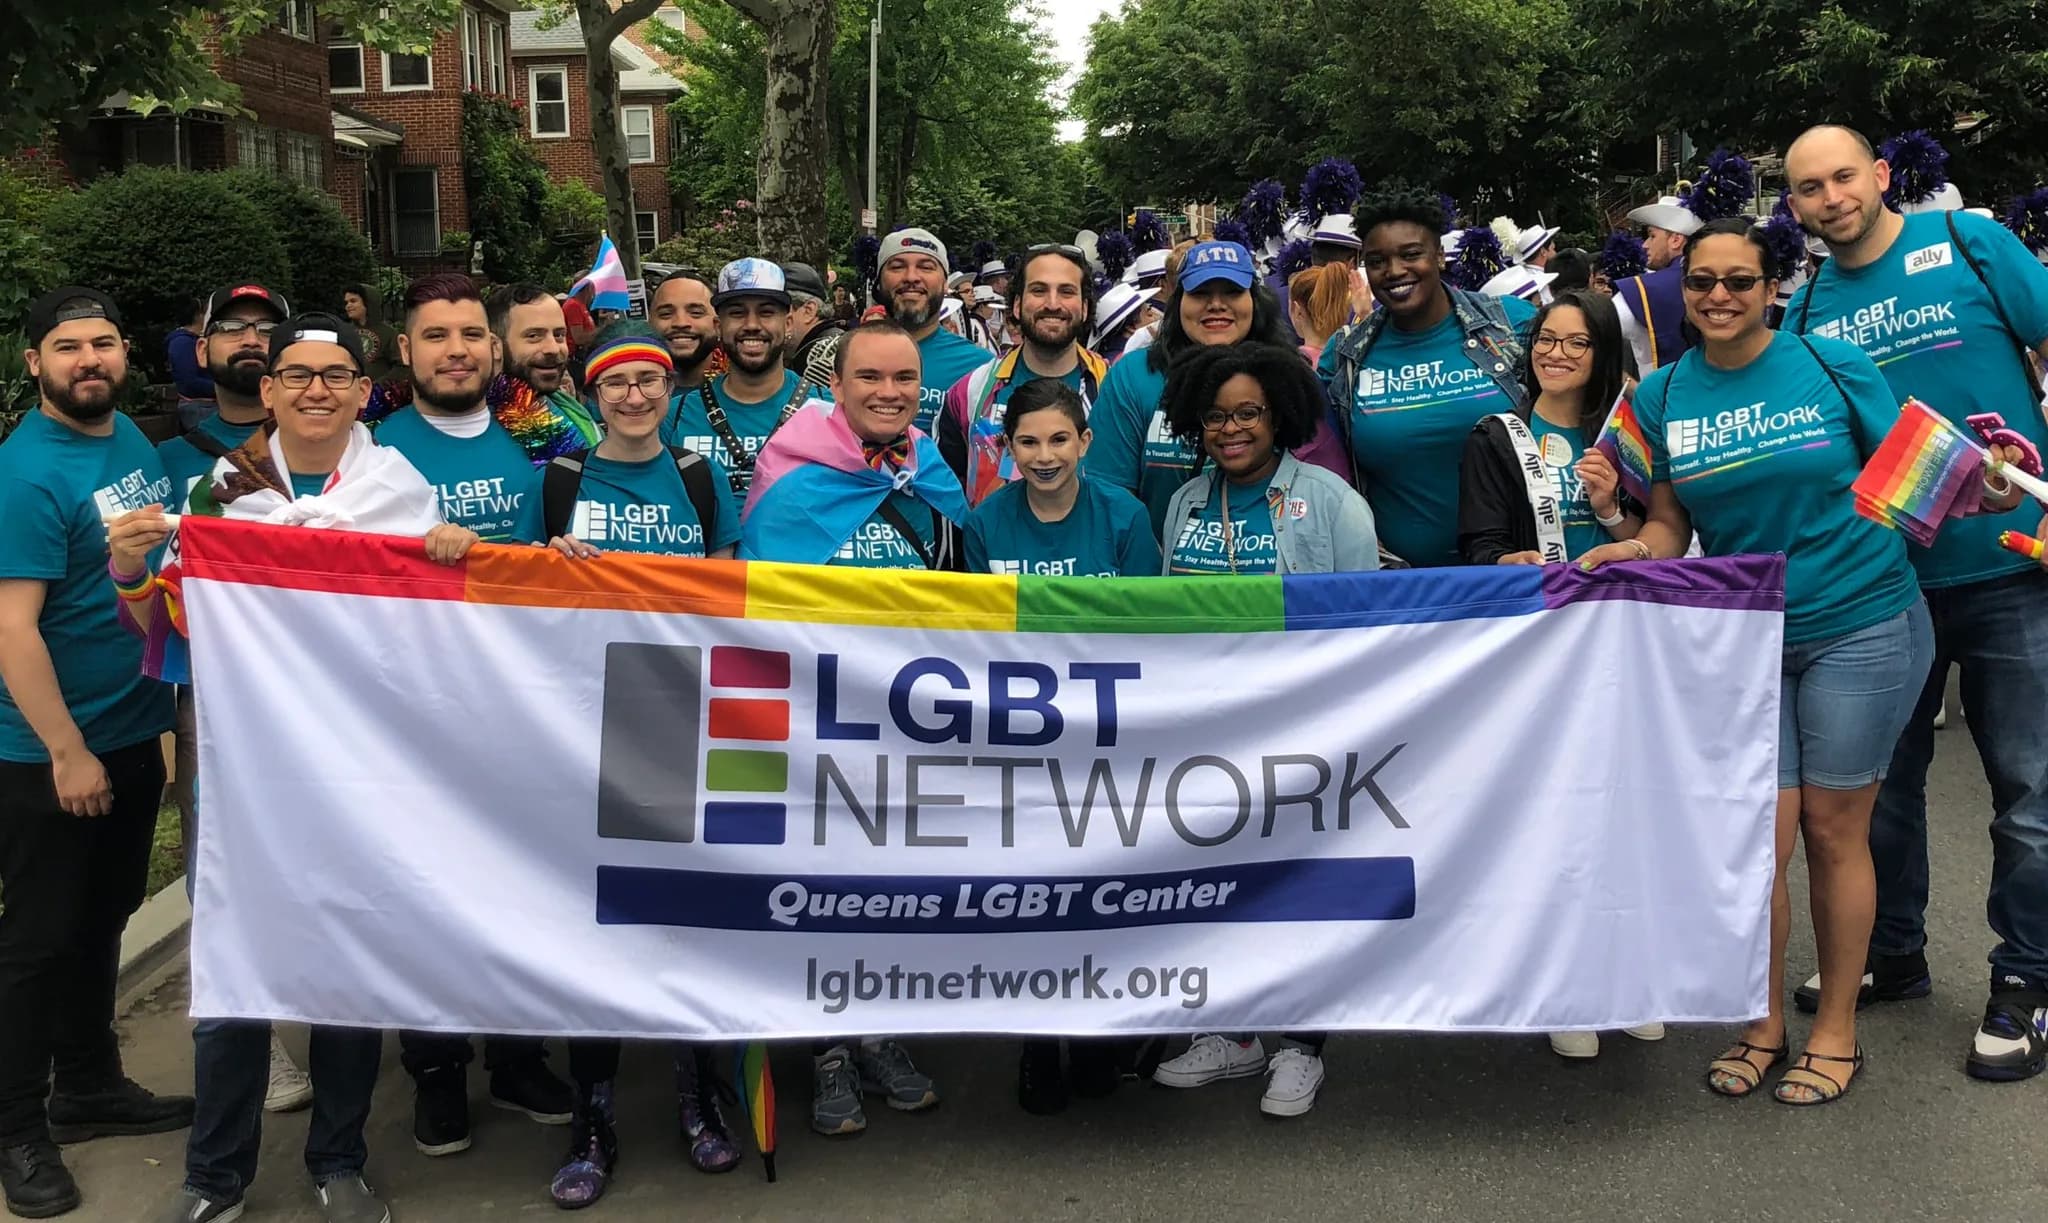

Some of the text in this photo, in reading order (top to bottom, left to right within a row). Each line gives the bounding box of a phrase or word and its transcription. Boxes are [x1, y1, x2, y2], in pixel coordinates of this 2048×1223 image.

[1913, 249, 1943, 268] ally
[1842, 296, 1898, 332] LGBT
[1843, 301, 1956, 346] NETWORK
[1388, 360, 1444, 381] LGBT
[1701, 404, 1824, 450] NETWORK
[1702, 401, 1766, 434] LGBT
[1704, 455, 1721, 464] Stay
[1758, 436, 1788, 449] Change
[1789, 431, 1802, 441] the
[1524, 452, 1544, 479] ally
[112, 468, 148, 499] LGBT
[123, 475, 173, 512] NETWOR
[441, 477, 504, 500] LGBT
[444, 493, 524, 518] NETWO
[610, 503, 671, 524] LGBT
[1289, 501, 1304, 513] HE
[1537, 495, 1556, 525] ally
[610, 522, 703, 543] NETWOR
[1187, 534, 1278, 553] NETWOR
[1544, 541, 1564, 563] lly
[815, 653, 1141, 750] LGBT
[813, 742, 1411, 848] NETWORK
[768, 876, 1237, 924] Queens LGBT Center
[806, 955, 1210, 1014] lgbtnetwork.org
